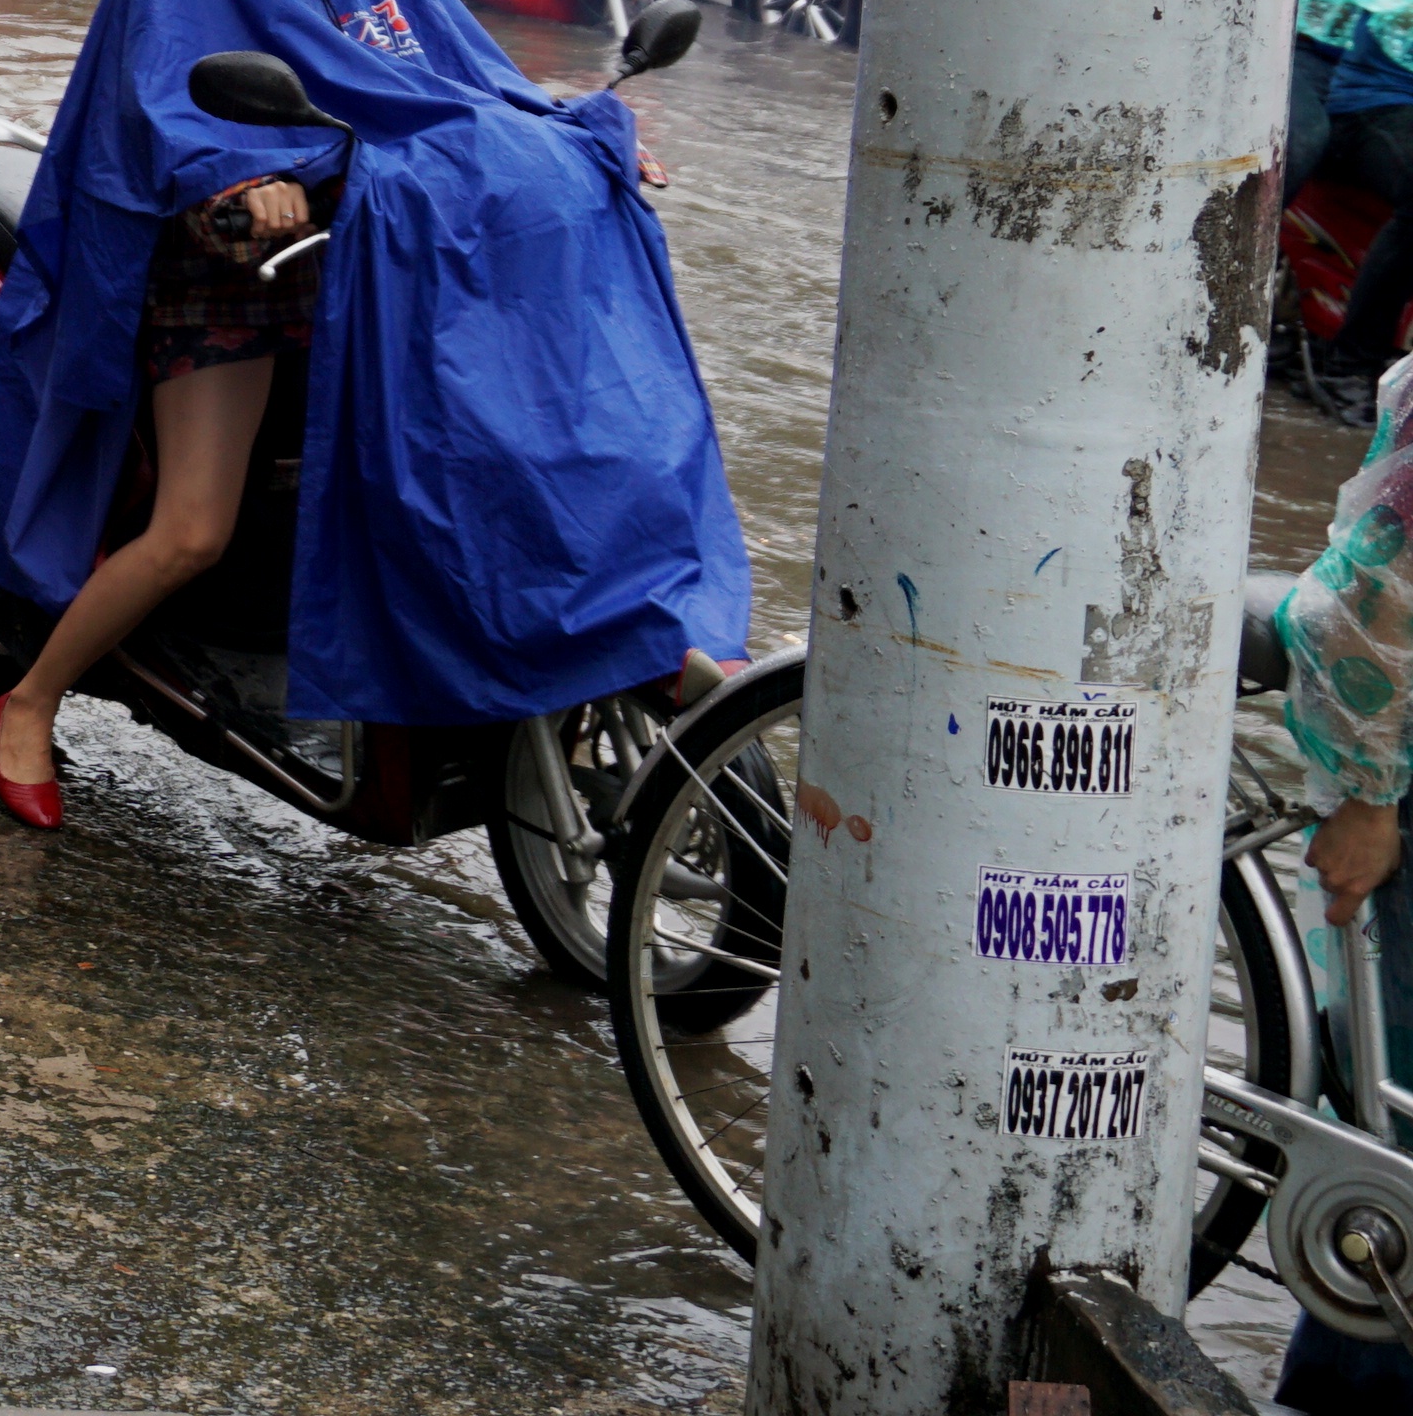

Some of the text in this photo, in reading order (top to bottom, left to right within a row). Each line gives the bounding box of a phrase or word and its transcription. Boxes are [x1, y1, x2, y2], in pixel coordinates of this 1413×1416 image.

[989, 700, 1032, 713] HÚT
[988, 718, 1133, 793] 0966.899.811
[984, 872, 1025, 884] HÚT
[978, 886, 1125, 964] 0908.505.778
[1011, 1051, 1053, 1064] HÚT
[1007, 1066, 1145, 1139] 0937.207.207
